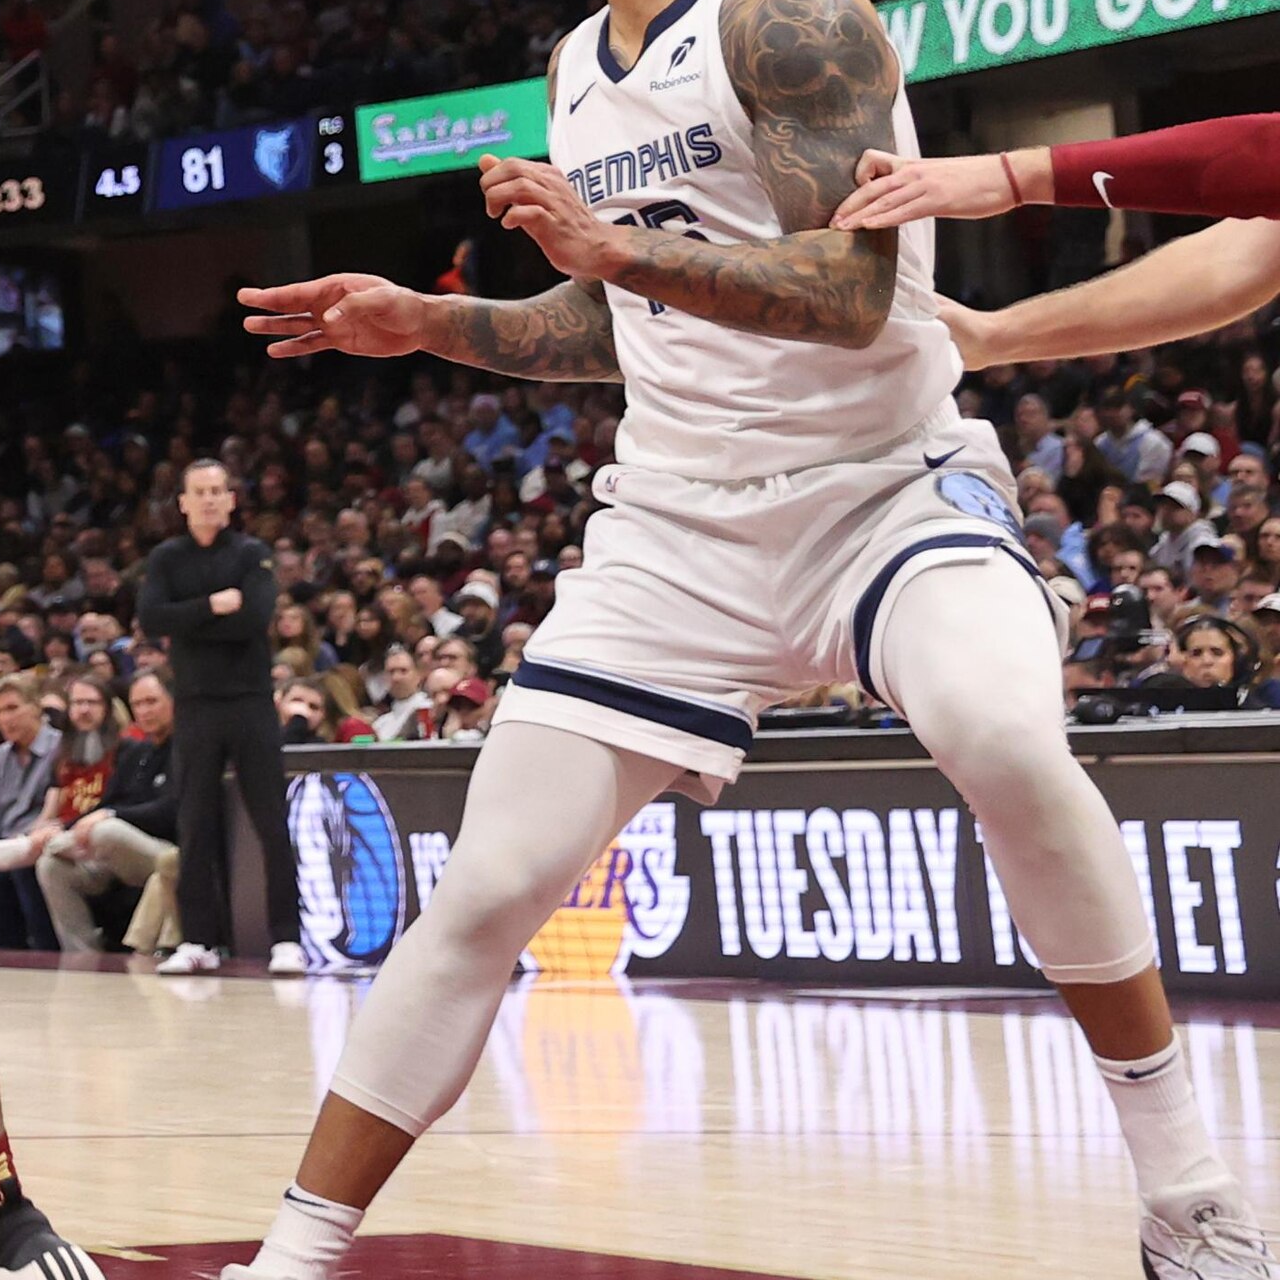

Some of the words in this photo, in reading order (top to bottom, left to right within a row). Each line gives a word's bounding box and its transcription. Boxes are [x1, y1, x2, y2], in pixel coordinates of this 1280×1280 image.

[95, 165, 141, 199] 4.5
[181, 145, 225, 194] 81
[324, 142, 344, 175] 3
[567, 122, 723, 206] MEMPHIS
[700, 807, 962, 965] TUESDAY
